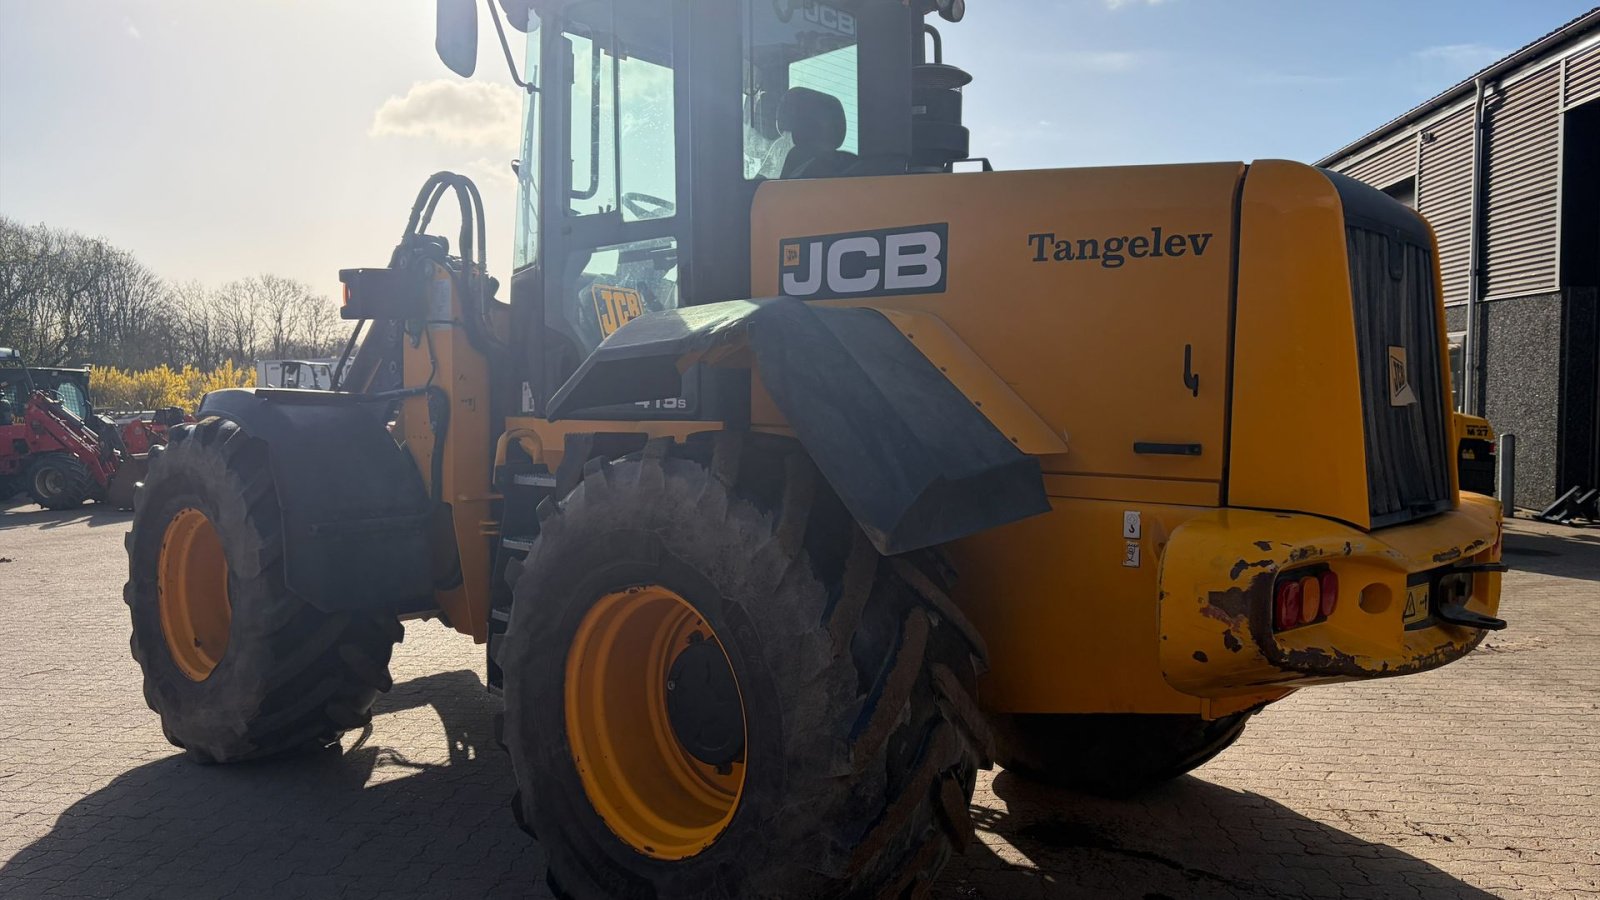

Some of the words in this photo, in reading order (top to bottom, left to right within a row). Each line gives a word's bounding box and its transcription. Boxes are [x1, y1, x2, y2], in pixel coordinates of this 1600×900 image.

[804, 1, 855, 34] JCB
[783, 231, 942, 296] JCB
[1028, 227, 1213, 268] Tangelev
[601, 290, 640, 334] JCB
[1477, 429, 1488, 437] 27
